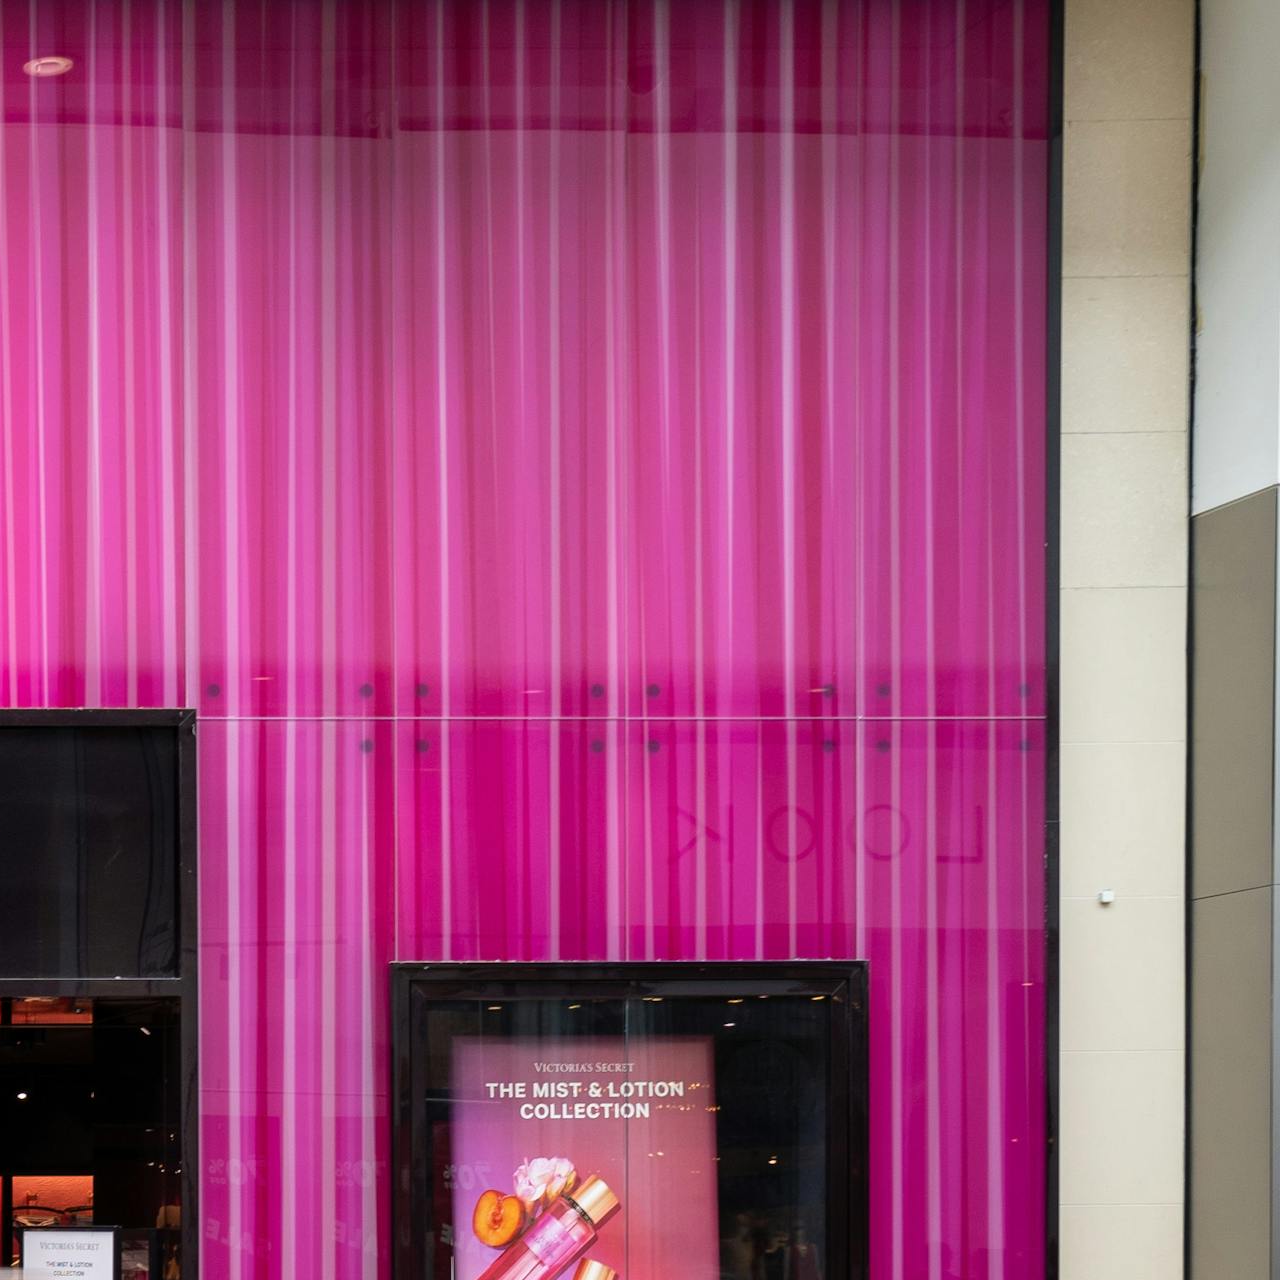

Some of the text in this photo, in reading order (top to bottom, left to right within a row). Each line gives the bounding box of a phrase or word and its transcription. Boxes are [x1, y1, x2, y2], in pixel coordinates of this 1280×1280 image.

[533, 1062, 635, 1073] VICTORIA'S SECRET
[485, 1081, 685, 1098] THE MIST & LOTION
[520, 1103, 650, 1119] COLLECTION
[75, 1241, 100, 1251] SECRET
